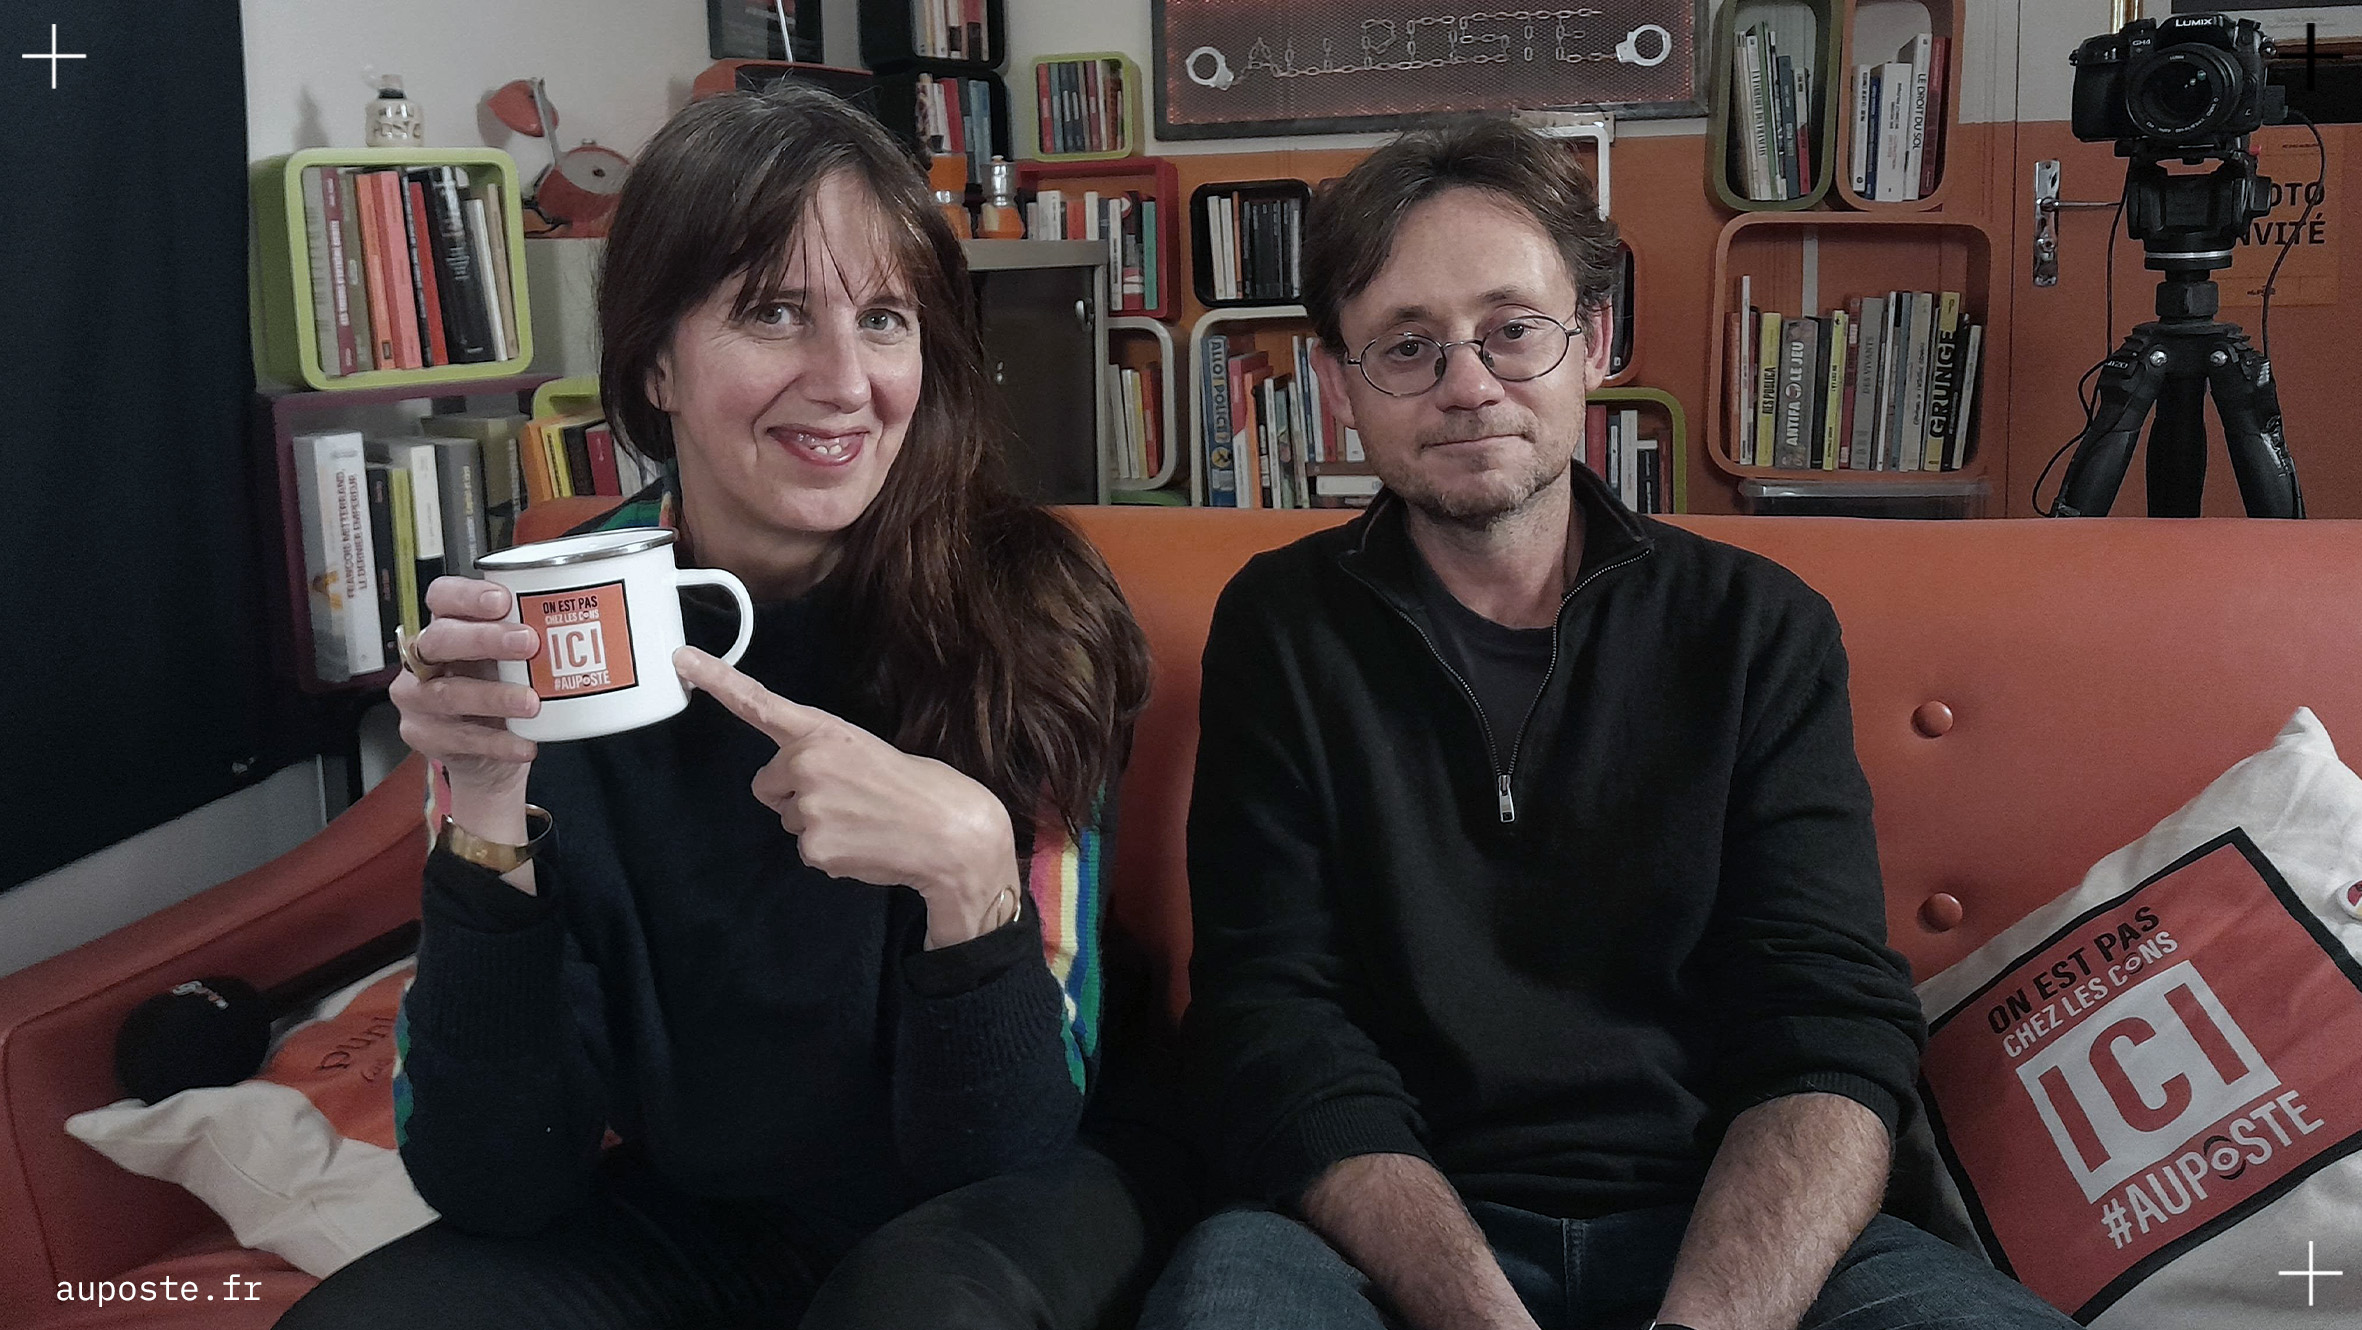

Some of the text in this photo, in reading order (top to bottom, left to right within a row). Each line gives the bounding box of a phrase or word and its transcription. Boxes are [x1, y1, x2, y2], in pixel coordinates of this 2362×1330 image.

[2132, 38, 2151, 46] GH4
[2175, 18, 2213, 27] LUMIX
[1912, 73, 1927, 150] LE DROIT DU SOL
[2271, 182, 2325, 206] OTO
[1786, 341, 1804, 446] ANTIFA LE JEU
[1930, 329, 1956, 437] GRUNGE
[542, 595, 598, 614] ON EST PAS
[545, 613, 563, 625] CHEZ
[564, 611, 578, 623] LES
[551, 627, 602, 670] ICI
[554, 671, 611, 690] #AUPOSTE
[1987, 906, 2159, 1034] ON EST PAS
[2002, 931, 2178, 1058] CHEZ LES CONS
[2037, 982, 2250, 1174] ICI
[2101, 1090, 2325, 1249] #AUPOSTE
